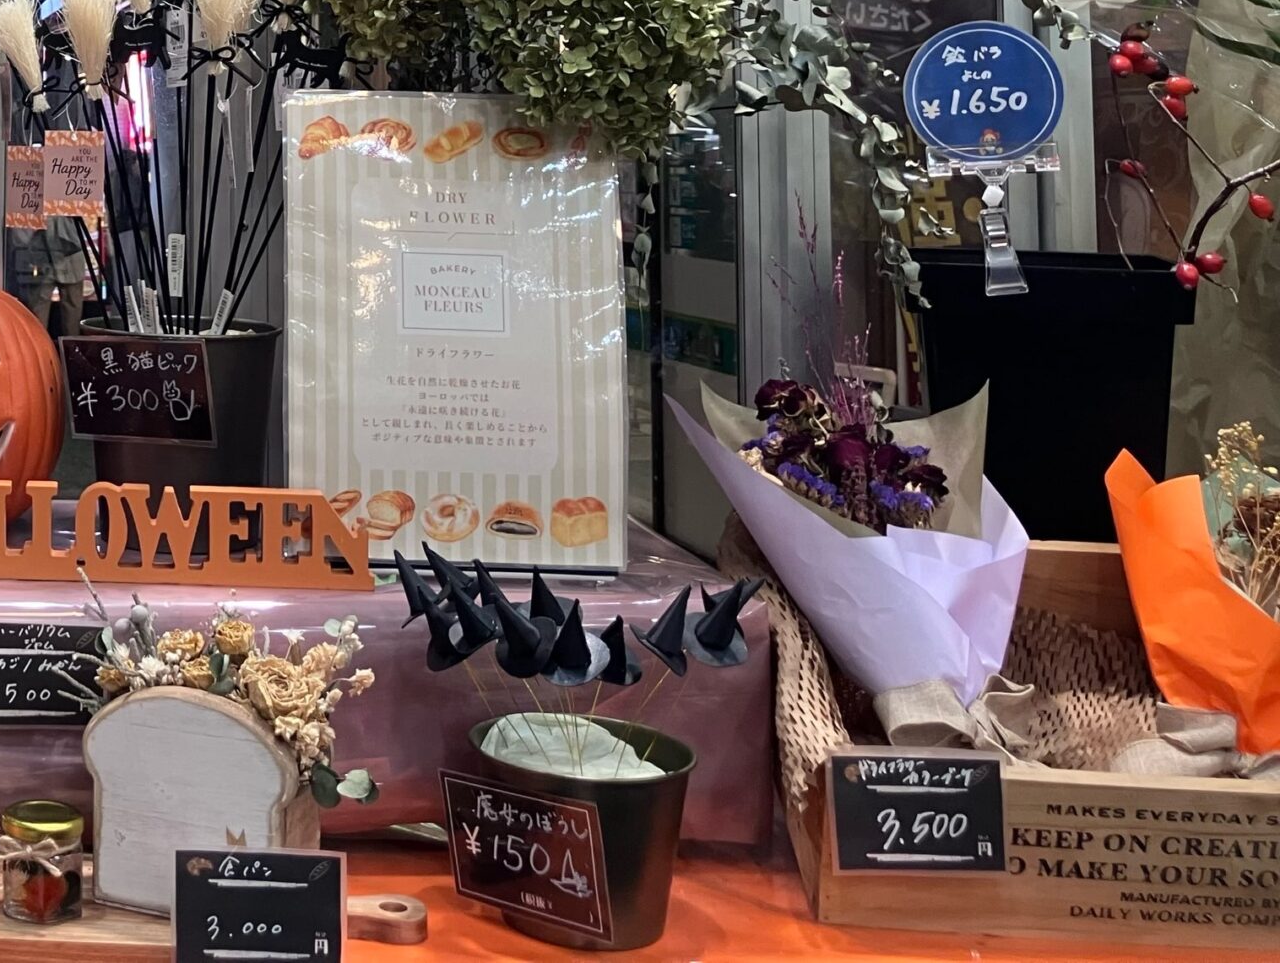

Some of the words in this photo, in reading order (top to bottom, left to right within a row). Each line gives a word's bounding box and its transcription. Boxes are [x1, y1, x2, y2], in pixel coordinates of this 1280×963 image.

[51, 158, 91, 178] Happy
[65, 179, 91, 199] Day
[435, 192, 467, 204] DRY
[430, 265, 476, 276] BAKERY
[415, 285, 491, 299] MONCEAU
[424, 300, 484, 313] FLEURS
[100, 347, 198, 375] 黒猫ピック
[416, 347, 495, 359] ドライフラワー
[5, 683, 51, 703] 500
[1046, 804, 1126, 818] MAKES
[1136, 809, 1257, 825] EVERYDAY
[1011, 828, 1094, 850] KEEP
[1103, 833, 1151, 853] ON
[1037, 858, 1128, 881] MAKE
[1140, 864, 1230, 887] YOUR
[1120, 891, 1256, 908] MANUFACTURED
[1069, 905, 1132, 920] DAILY
[1140, 909, 1214, 925] WORKS
